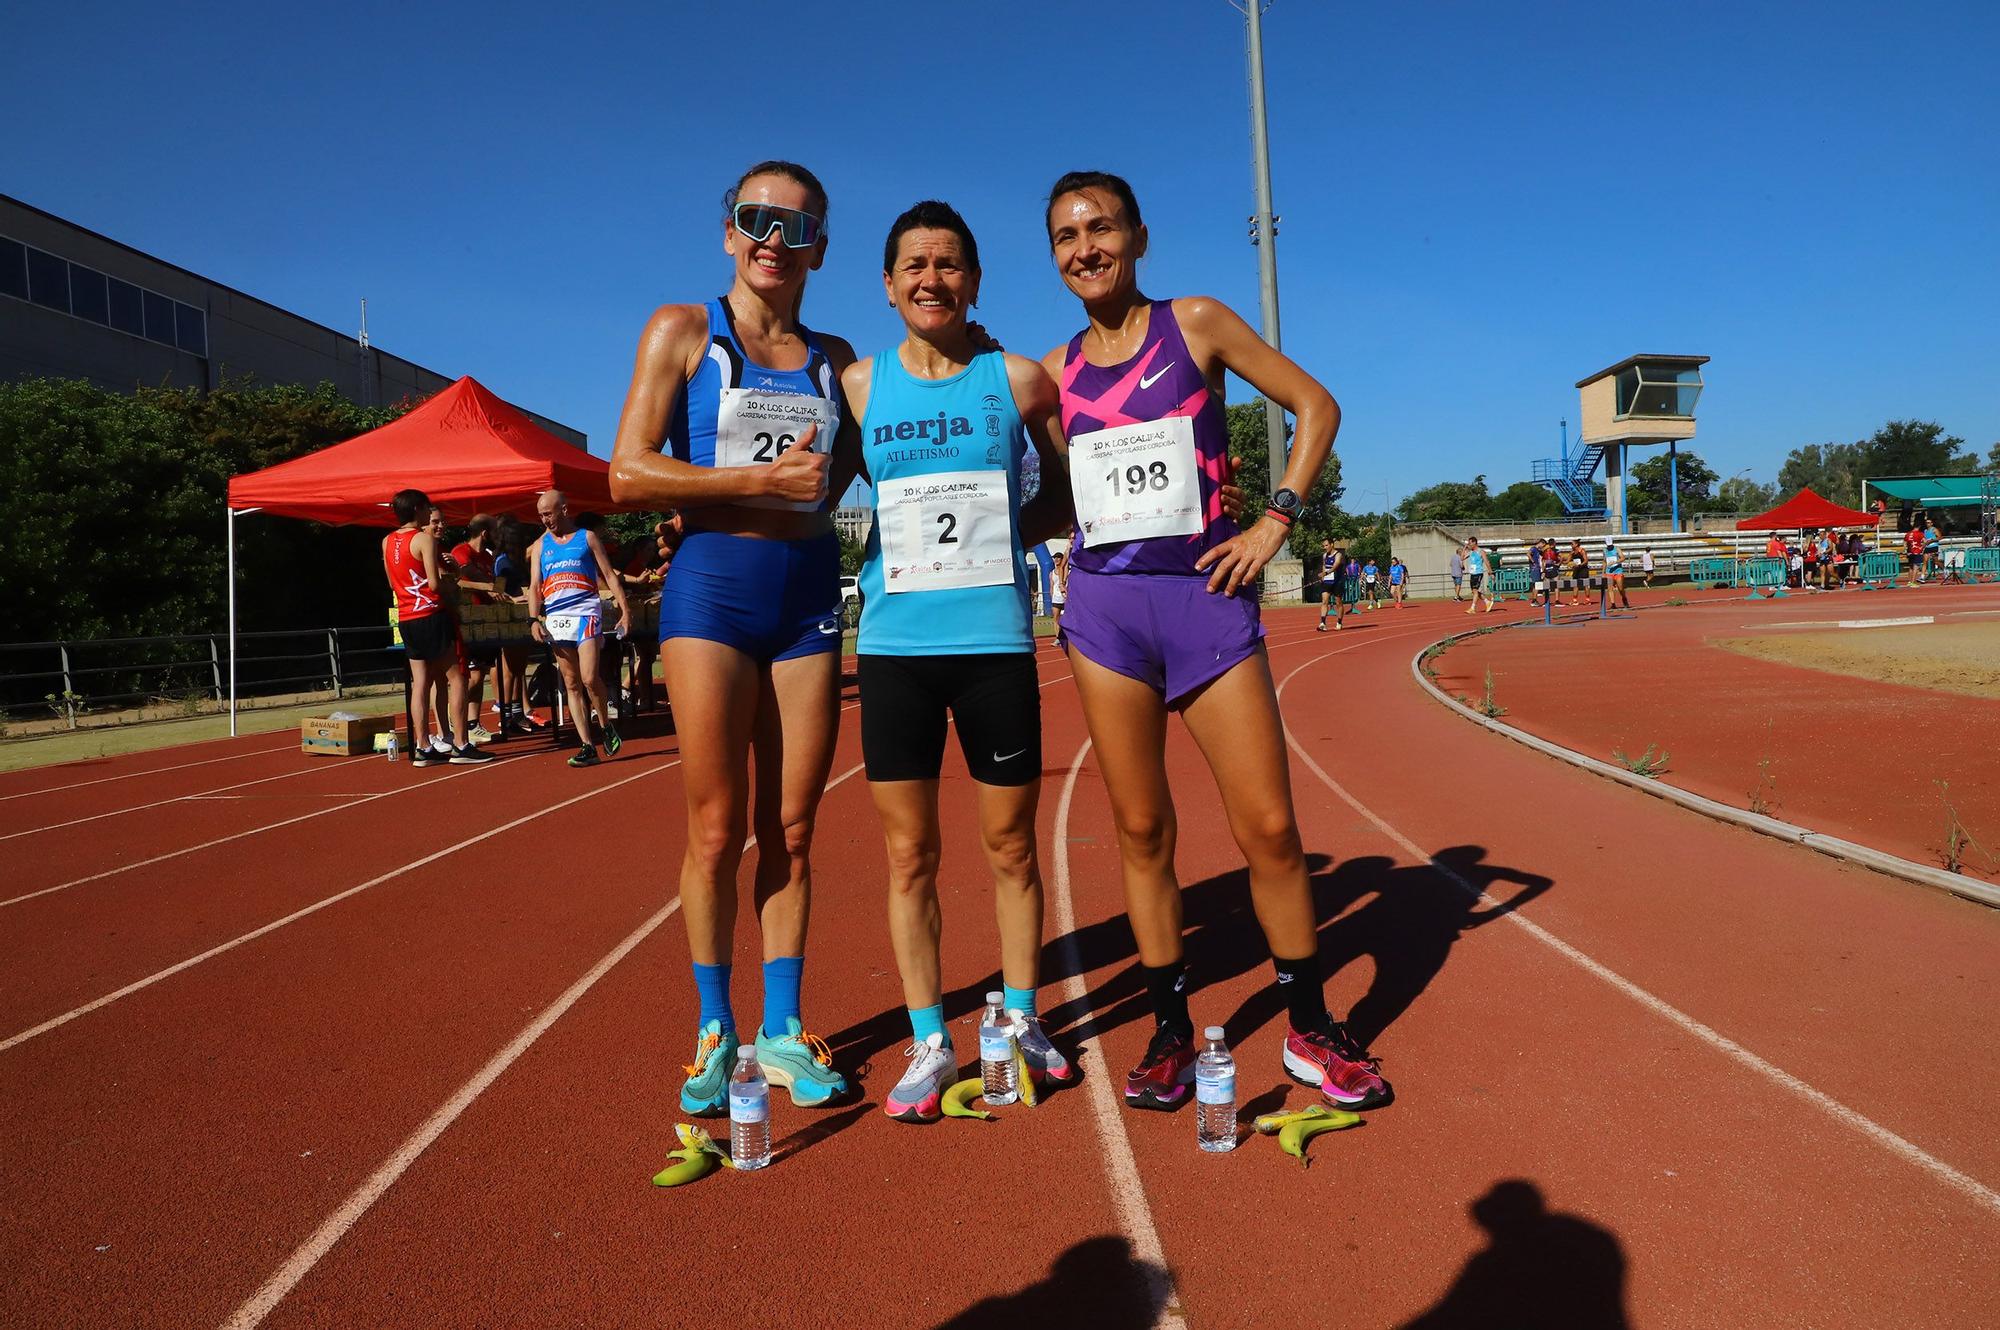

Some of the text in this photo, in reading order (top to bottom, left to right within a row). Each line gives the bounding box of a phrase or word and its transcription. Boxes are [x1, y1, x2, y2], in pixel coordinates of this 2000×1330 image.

[736, 411, 767, 420] CARRERAS
[768, 413, 800, 422] POPULARES
[747, 401, 818, 416] 10 K LOS CALIFAS
[873, 411, 973, 446] nerja
[1093, 431, 1165, 450] 10 K LOS CALIFAS
[885, 446, 960, 463] ATLETISMO
[1106, 461, 1169, 497] 198
[903, 483, 978, 497] 10 K LOS CALIFAS
[936, 513, 958, 544] 2
[552, 619, 571, 629] 365
[310, 721, 340, 729] BANANAS
